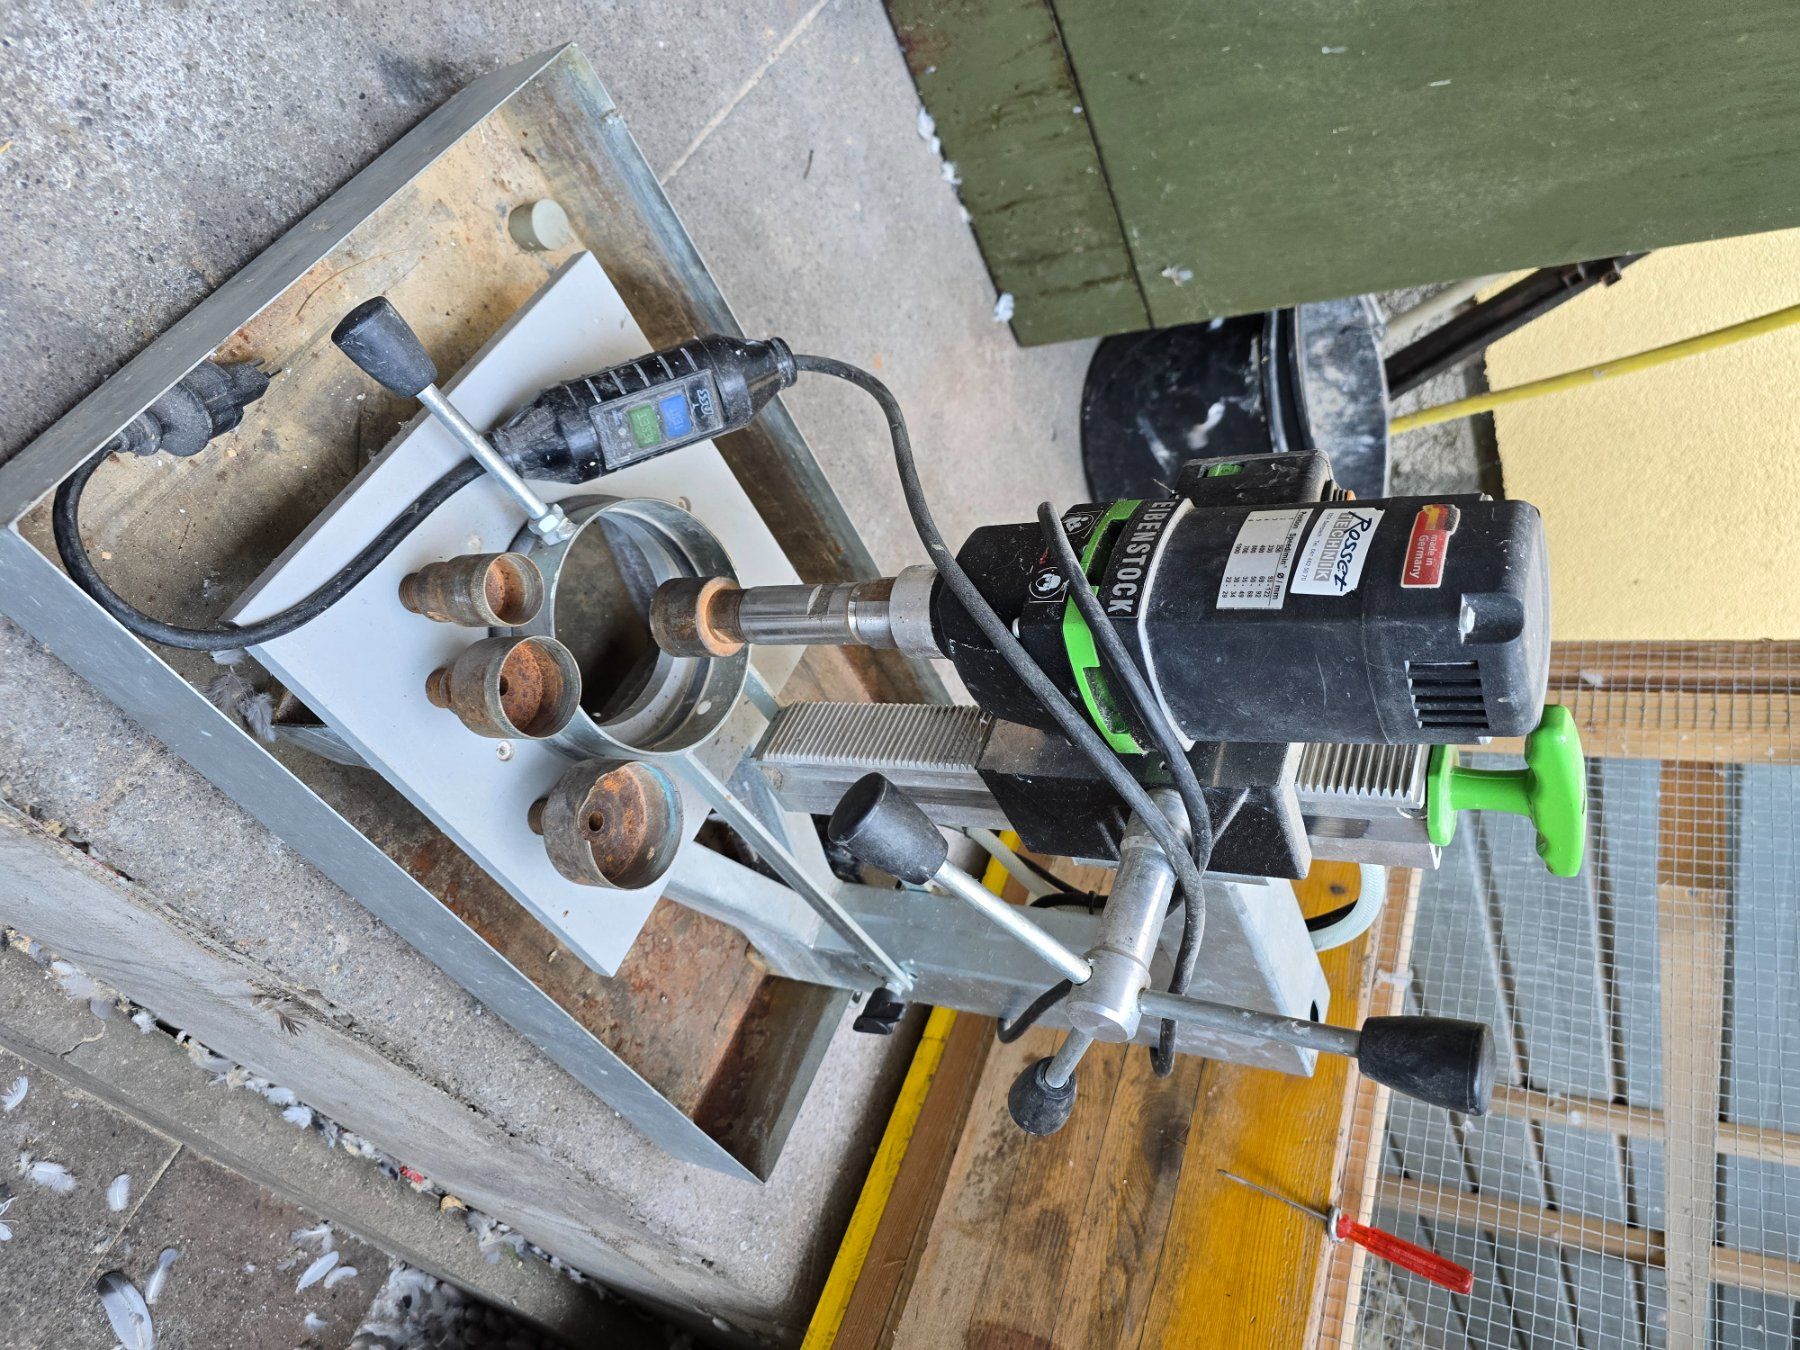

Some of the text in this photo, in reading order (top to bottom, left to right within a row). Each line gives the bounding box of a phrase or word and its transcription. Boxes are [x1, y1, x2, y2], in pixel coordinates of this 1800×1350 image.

[636, 413, 653, 445] RESET
[1107, 501, 1176, 612] EIBENSTOCK
[1334, 511, 1373, 591] Rosset
[1409, 535, 1429, 579] Germany
[1425, 534, 1438, 566] made in
[1272, 585, 1279, 600] mm
